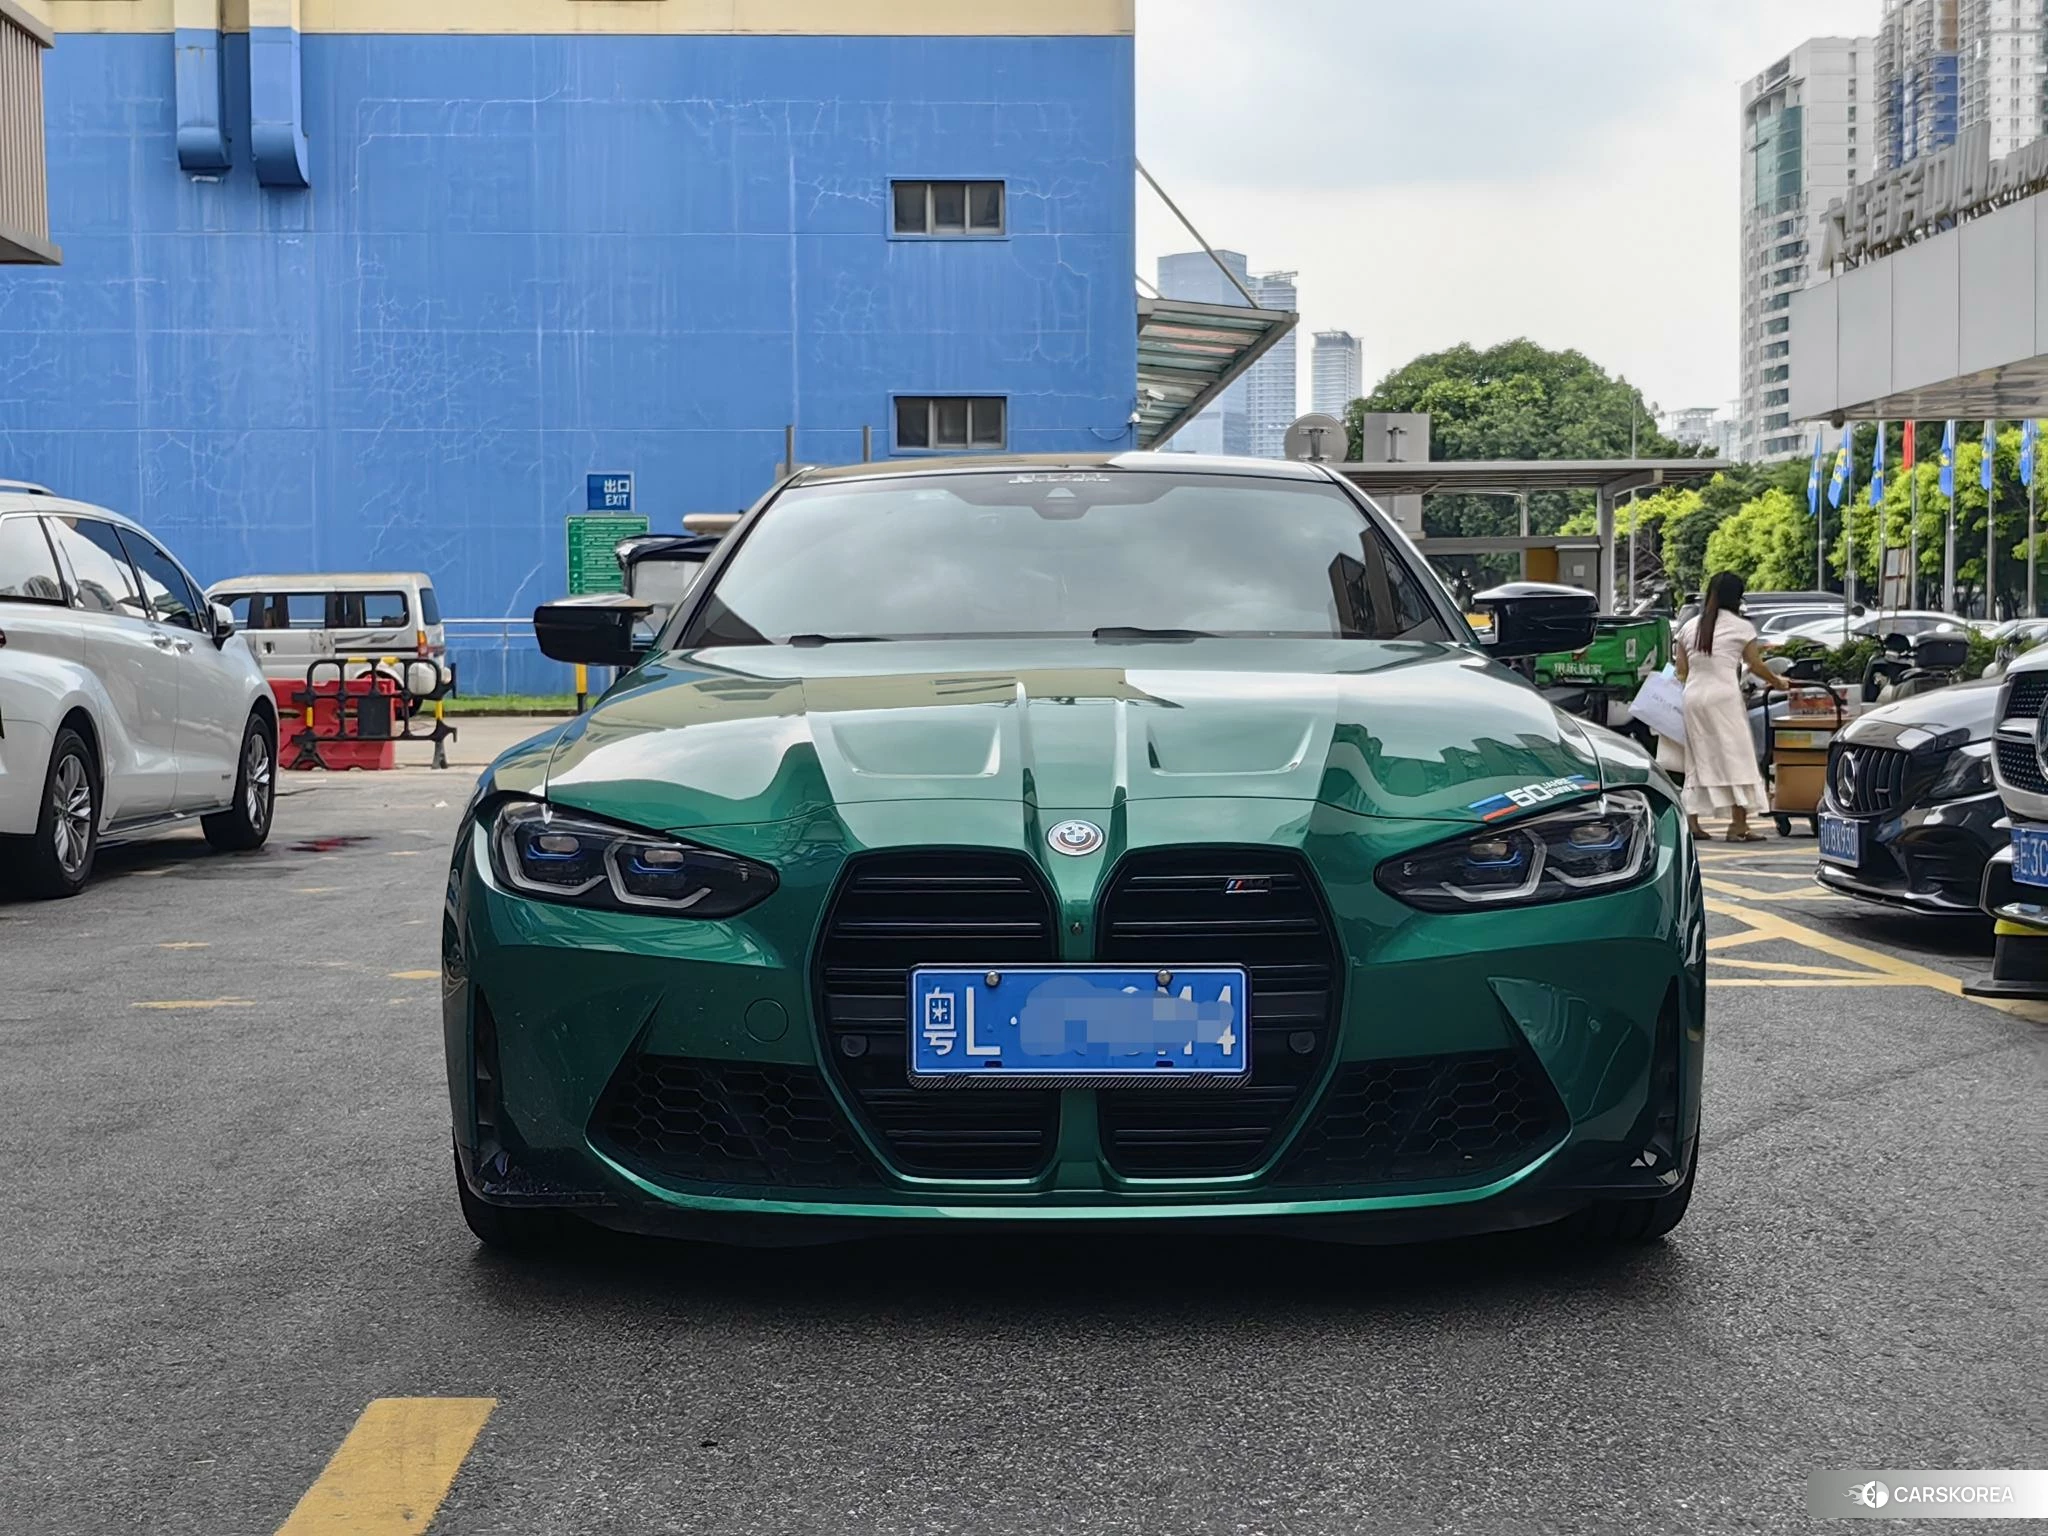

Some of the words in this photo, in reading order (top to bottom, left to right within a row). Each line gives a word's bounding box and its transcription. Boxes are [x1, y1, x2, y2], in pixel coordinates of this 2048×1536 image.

[604, 479, 630, 493] 出口
[605, 494, 629, 506] EXIT
[1505, 784, 1554, 807] 50
